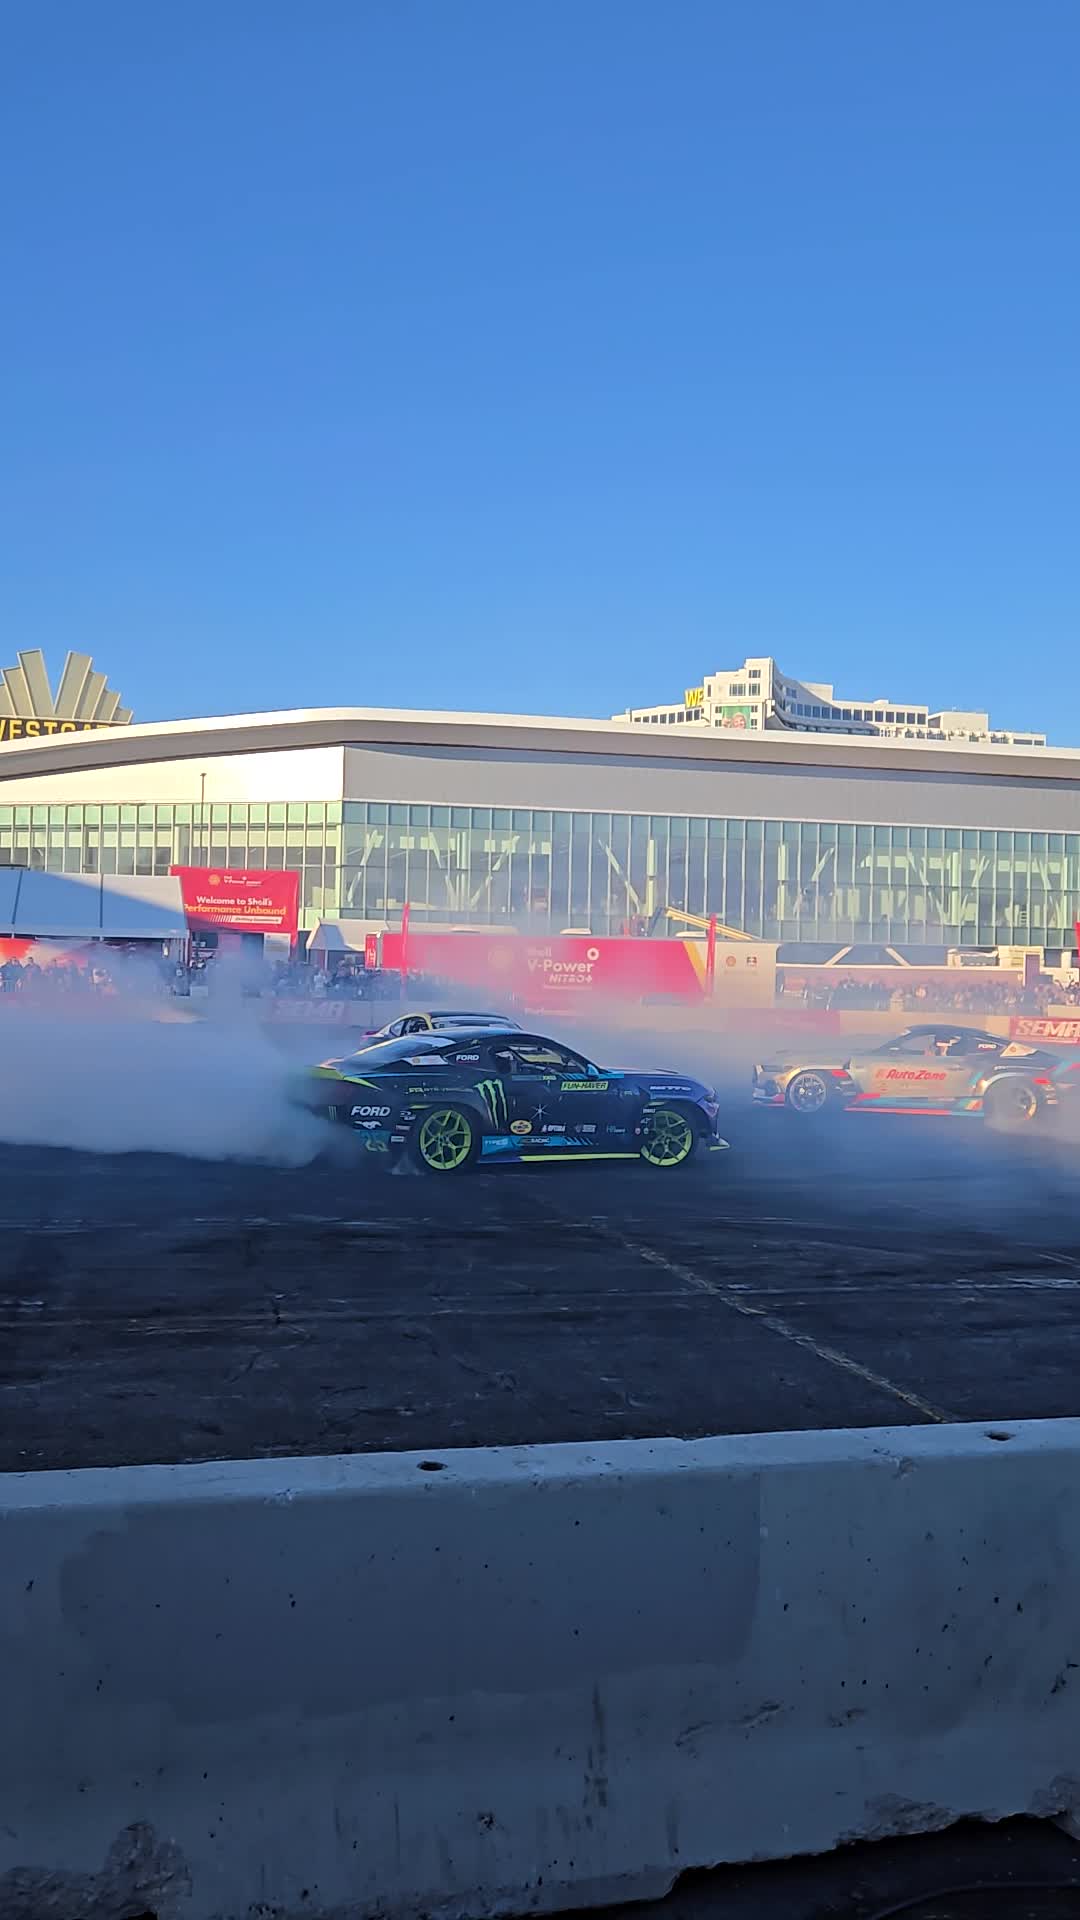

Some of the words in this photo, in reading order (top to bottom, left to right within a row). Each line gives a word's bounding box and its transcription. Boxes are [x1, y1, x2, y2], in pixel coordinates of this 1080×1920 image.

[0, 720, 110, 740] ESTG
[196, 896, 235, 905] Welcome
[244, 906, 287, 915] Unbound
[528, 959, 594, 974] V-Power
[886, 1068, 947, 1080] AutoZone
[350, 1105, 391, 1117] FORD
